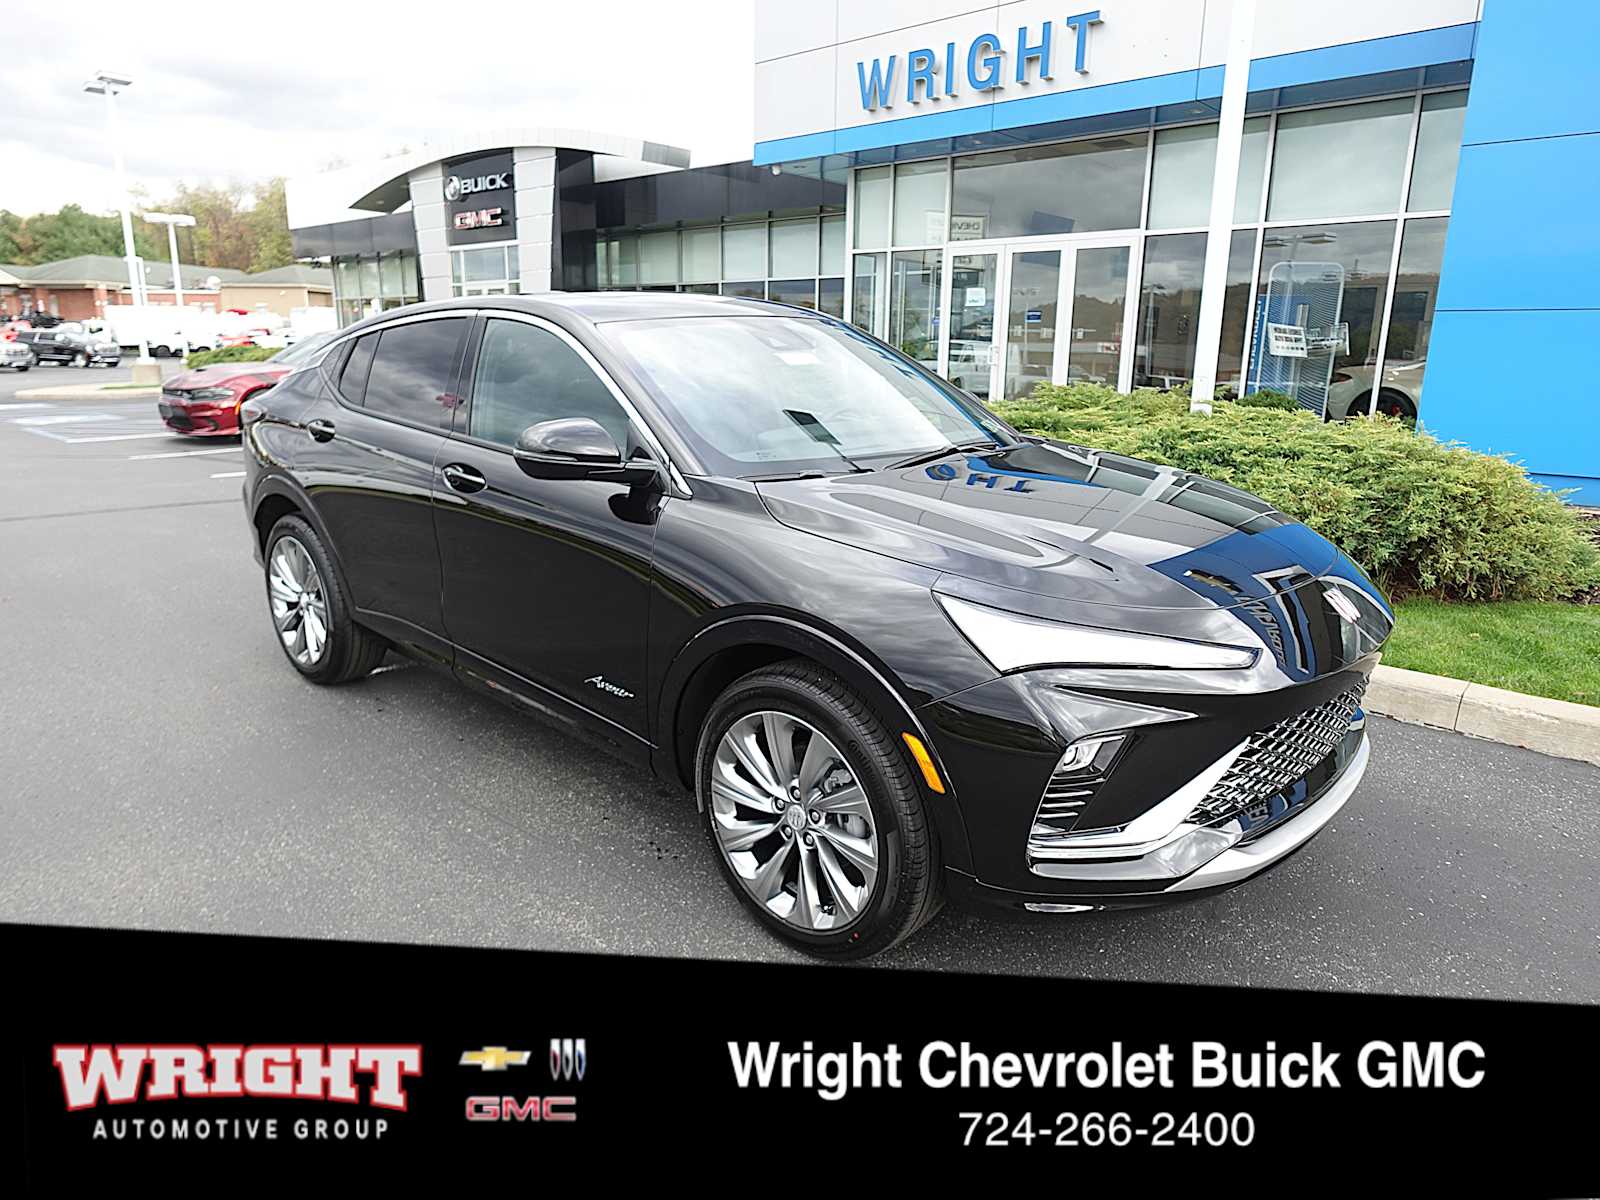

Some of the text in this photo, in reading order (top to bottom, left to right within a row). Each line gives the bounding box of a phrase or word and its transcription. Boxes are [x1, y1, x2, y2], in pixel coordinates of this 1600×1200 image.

[857, 10, 1104, 112] WRIGHT
[461, 173, 509, 194] BUICK
[454, 207, 503, 229] GMC
